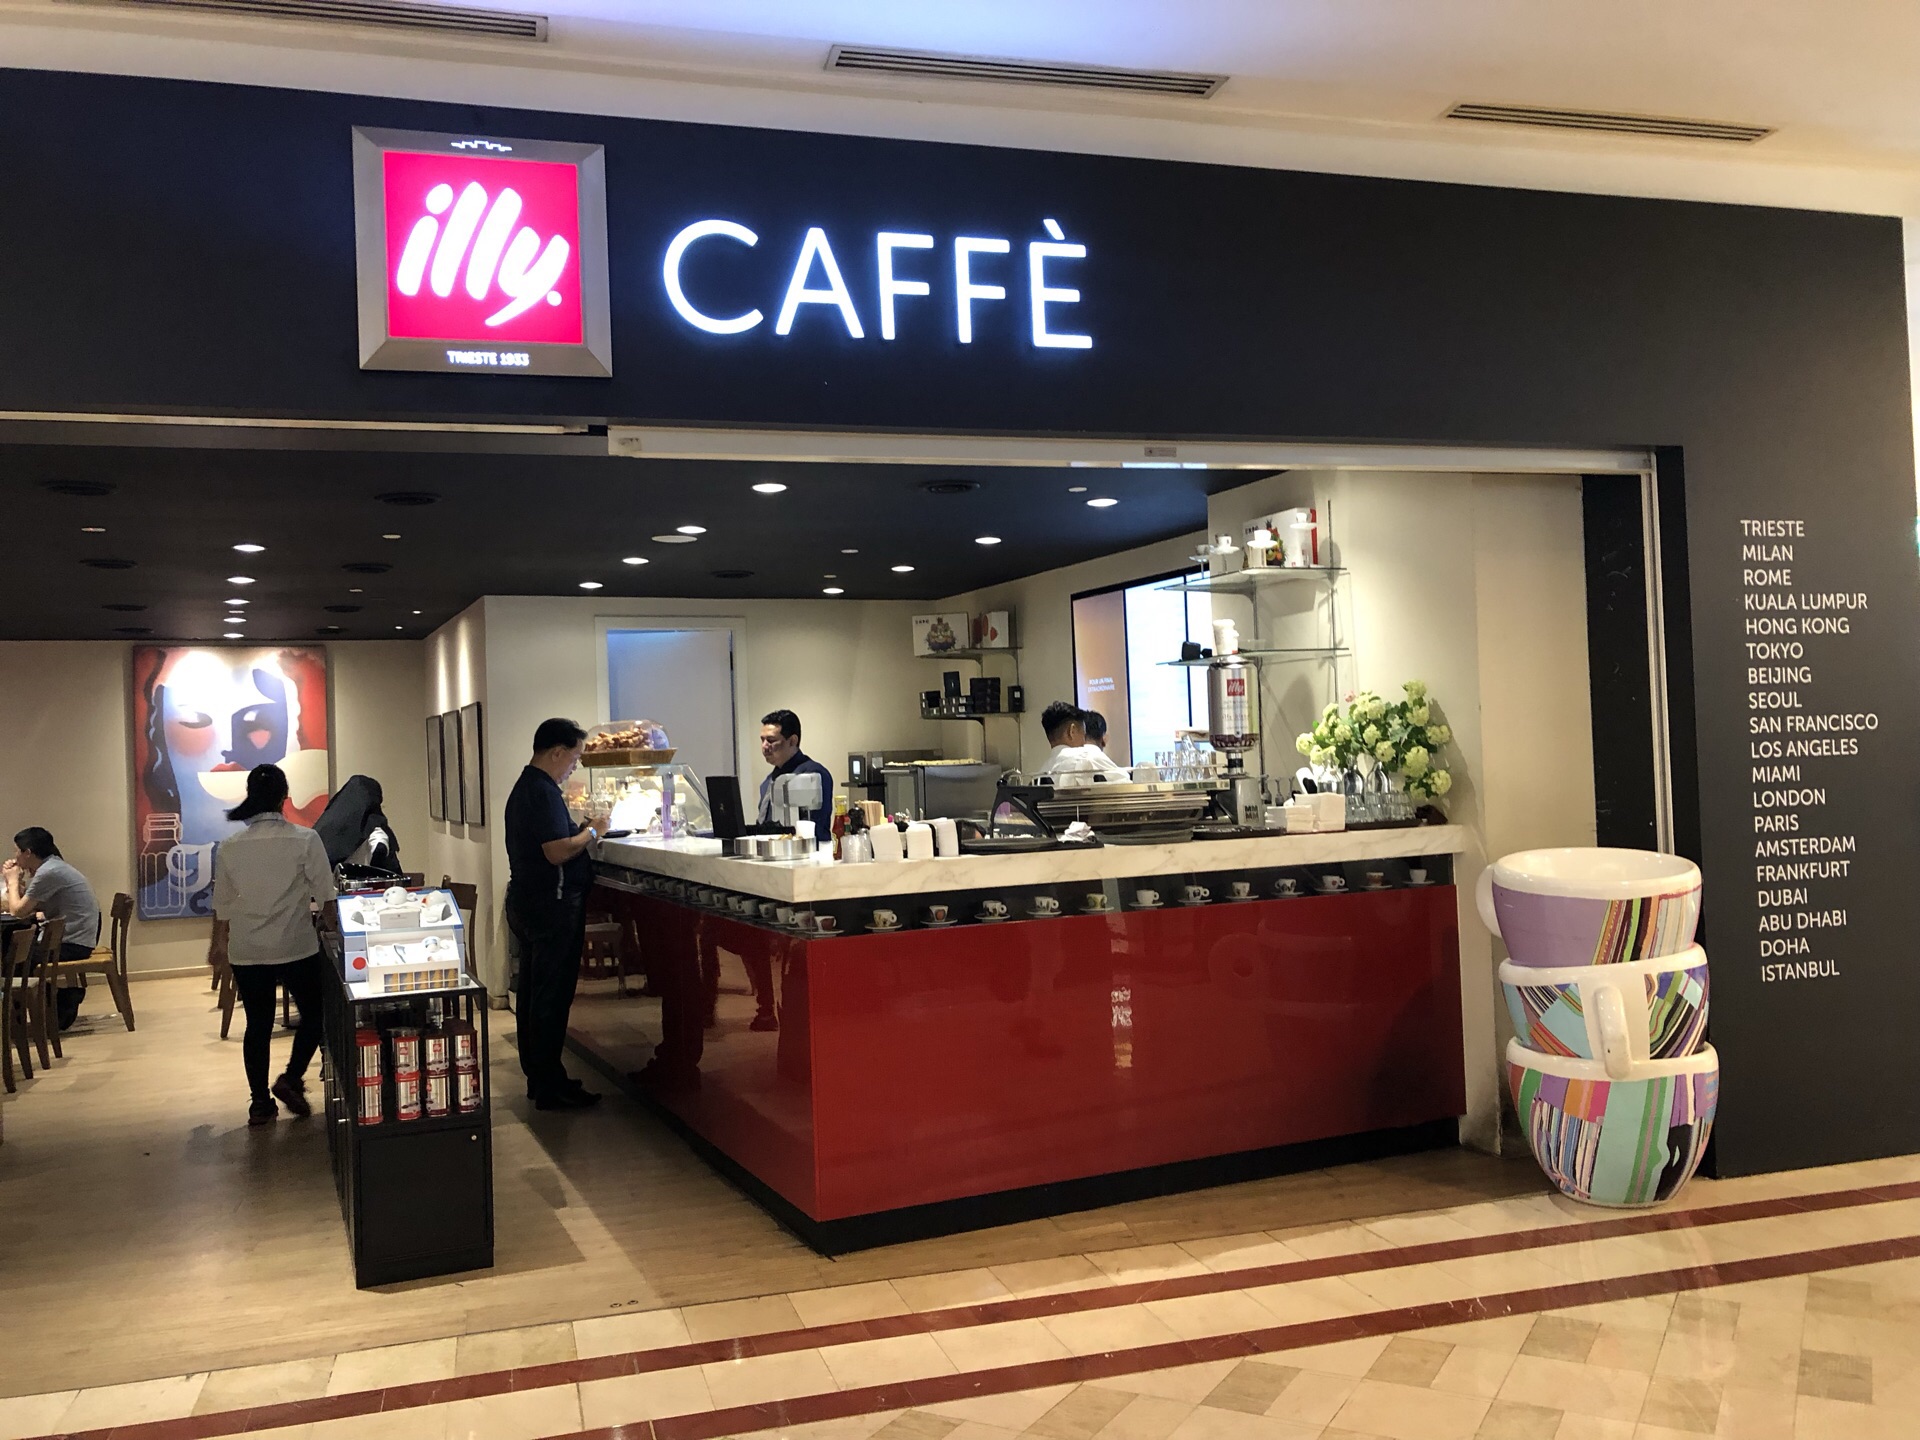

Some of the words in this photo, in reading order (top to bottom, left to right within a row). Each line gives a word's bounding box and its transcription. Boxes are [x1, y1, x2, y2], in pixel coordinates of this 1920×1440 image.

[662, 218, 1093, 349] CAFFÈ
[446, 350, 498, 364] TRIESTE
[1740, 519, 1805, 537] TRIESTE
[1742, 544, 1794, 562] MILAN
[1743, 568, 1792, 586] ROME
[1744, 593, 1798, 611] KUALA
[1801, 592, 1868, 610] LUMPUR
[1745, 617, 1797, 635] HONG
[1801, 616, 1850, 634] KONG
[1745, 641, 1804, 660] TOKYO
[1748, 666, 1812, 685] BEIJING
[1748, 691, 1803, 710] SEOUL
[1749, 716, 1782, 734] SAN
[1786, 713, 1879, 732] FRANCISCO
[1751, 740, 1783, 759] LOS
[1786, 738, 1859, 757] ANGELES
[1752, 764, 1801, 783] MIAMI
[1753, 788, 1826, 809] LONDON
[1754, 813, 1799, 833] PARIS
[1755, 835, 1856, 858] AMSTERDAM
[1756, 860, 1851, 883] FRANKFURT
[1758, 887, 1808, 908] DUBAI
[1758, 913, 1792, 933] ABU
[1797, 909, 1847, 930] DHABI
[1760, 937, 1811, 957] DOHA
[1761, 959, 1840, 982] ISTANBUL
